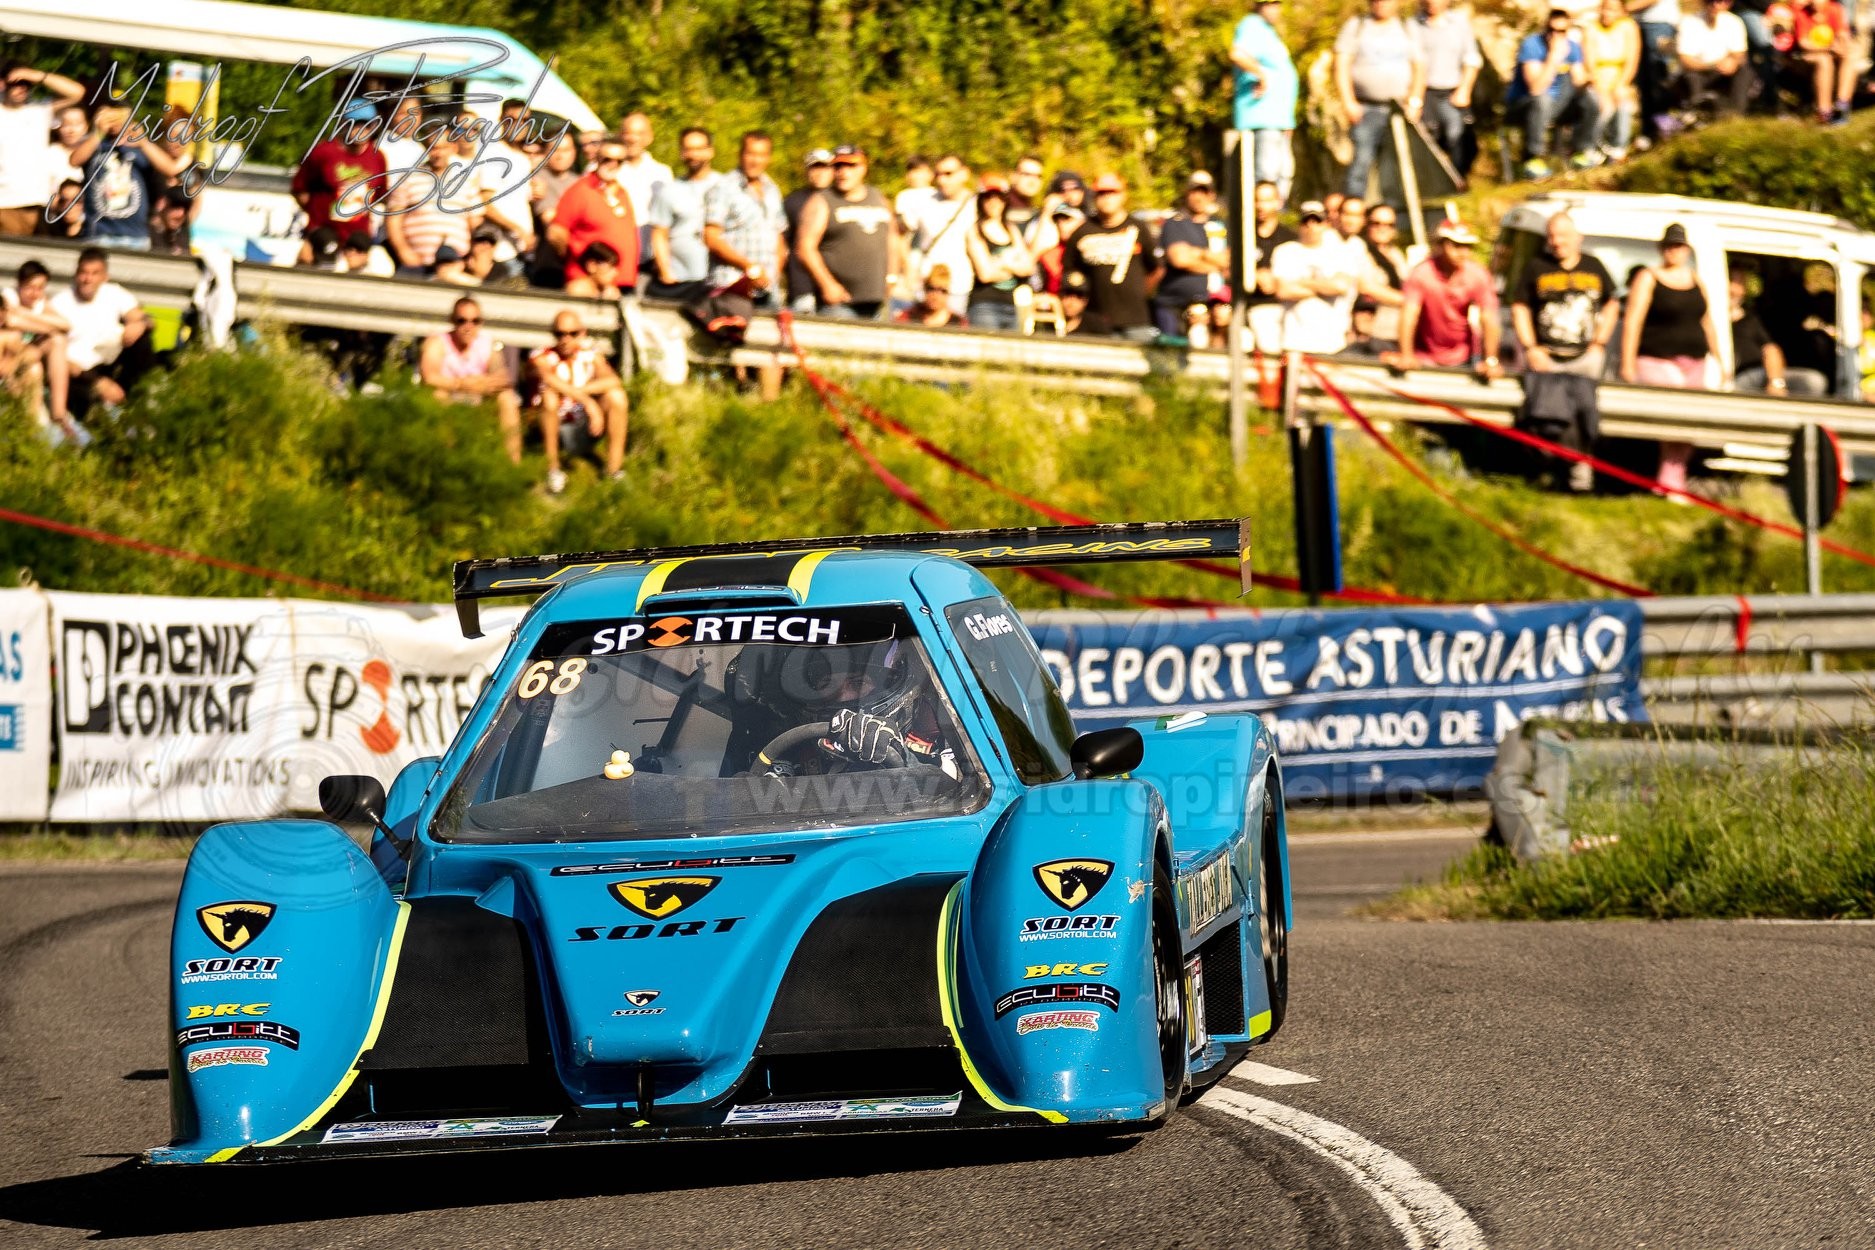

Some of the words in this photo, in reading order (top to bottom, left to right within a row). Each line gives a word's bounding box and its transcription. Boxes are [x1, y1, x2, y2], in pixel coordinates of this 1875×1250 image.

[1040, 639, 1295, 706] DEPORTE
[1306, 615, 1627, 690] ASTURIANO
[516, 656, 588, 699] 68
[302, 660, 494, 753] SPORTE
[1438, 709, 1483, 746] DE
[66, 758, 161, 790] INSPIRING
[165, 756, 290, 789] INNOVATIONS
[568, 916, 746, 942] SORT
[1019, 914, 1121, 935] SORT
[1018, 930, 1117, 943] WWW.SORTOIL.COM
[182, 957, 283, 976] SORT
[1022, 961, 1109, 979] BRC
[181, 971, 278, 984] WWW.SORTOIL.COM
[185, 1002, 272, 1019] BRC
[611, 1007, 667, 1017] SORT
[1021, 1012, 1099, 1027] KARTING
[190, 1048, 268, 1066] KARTING
